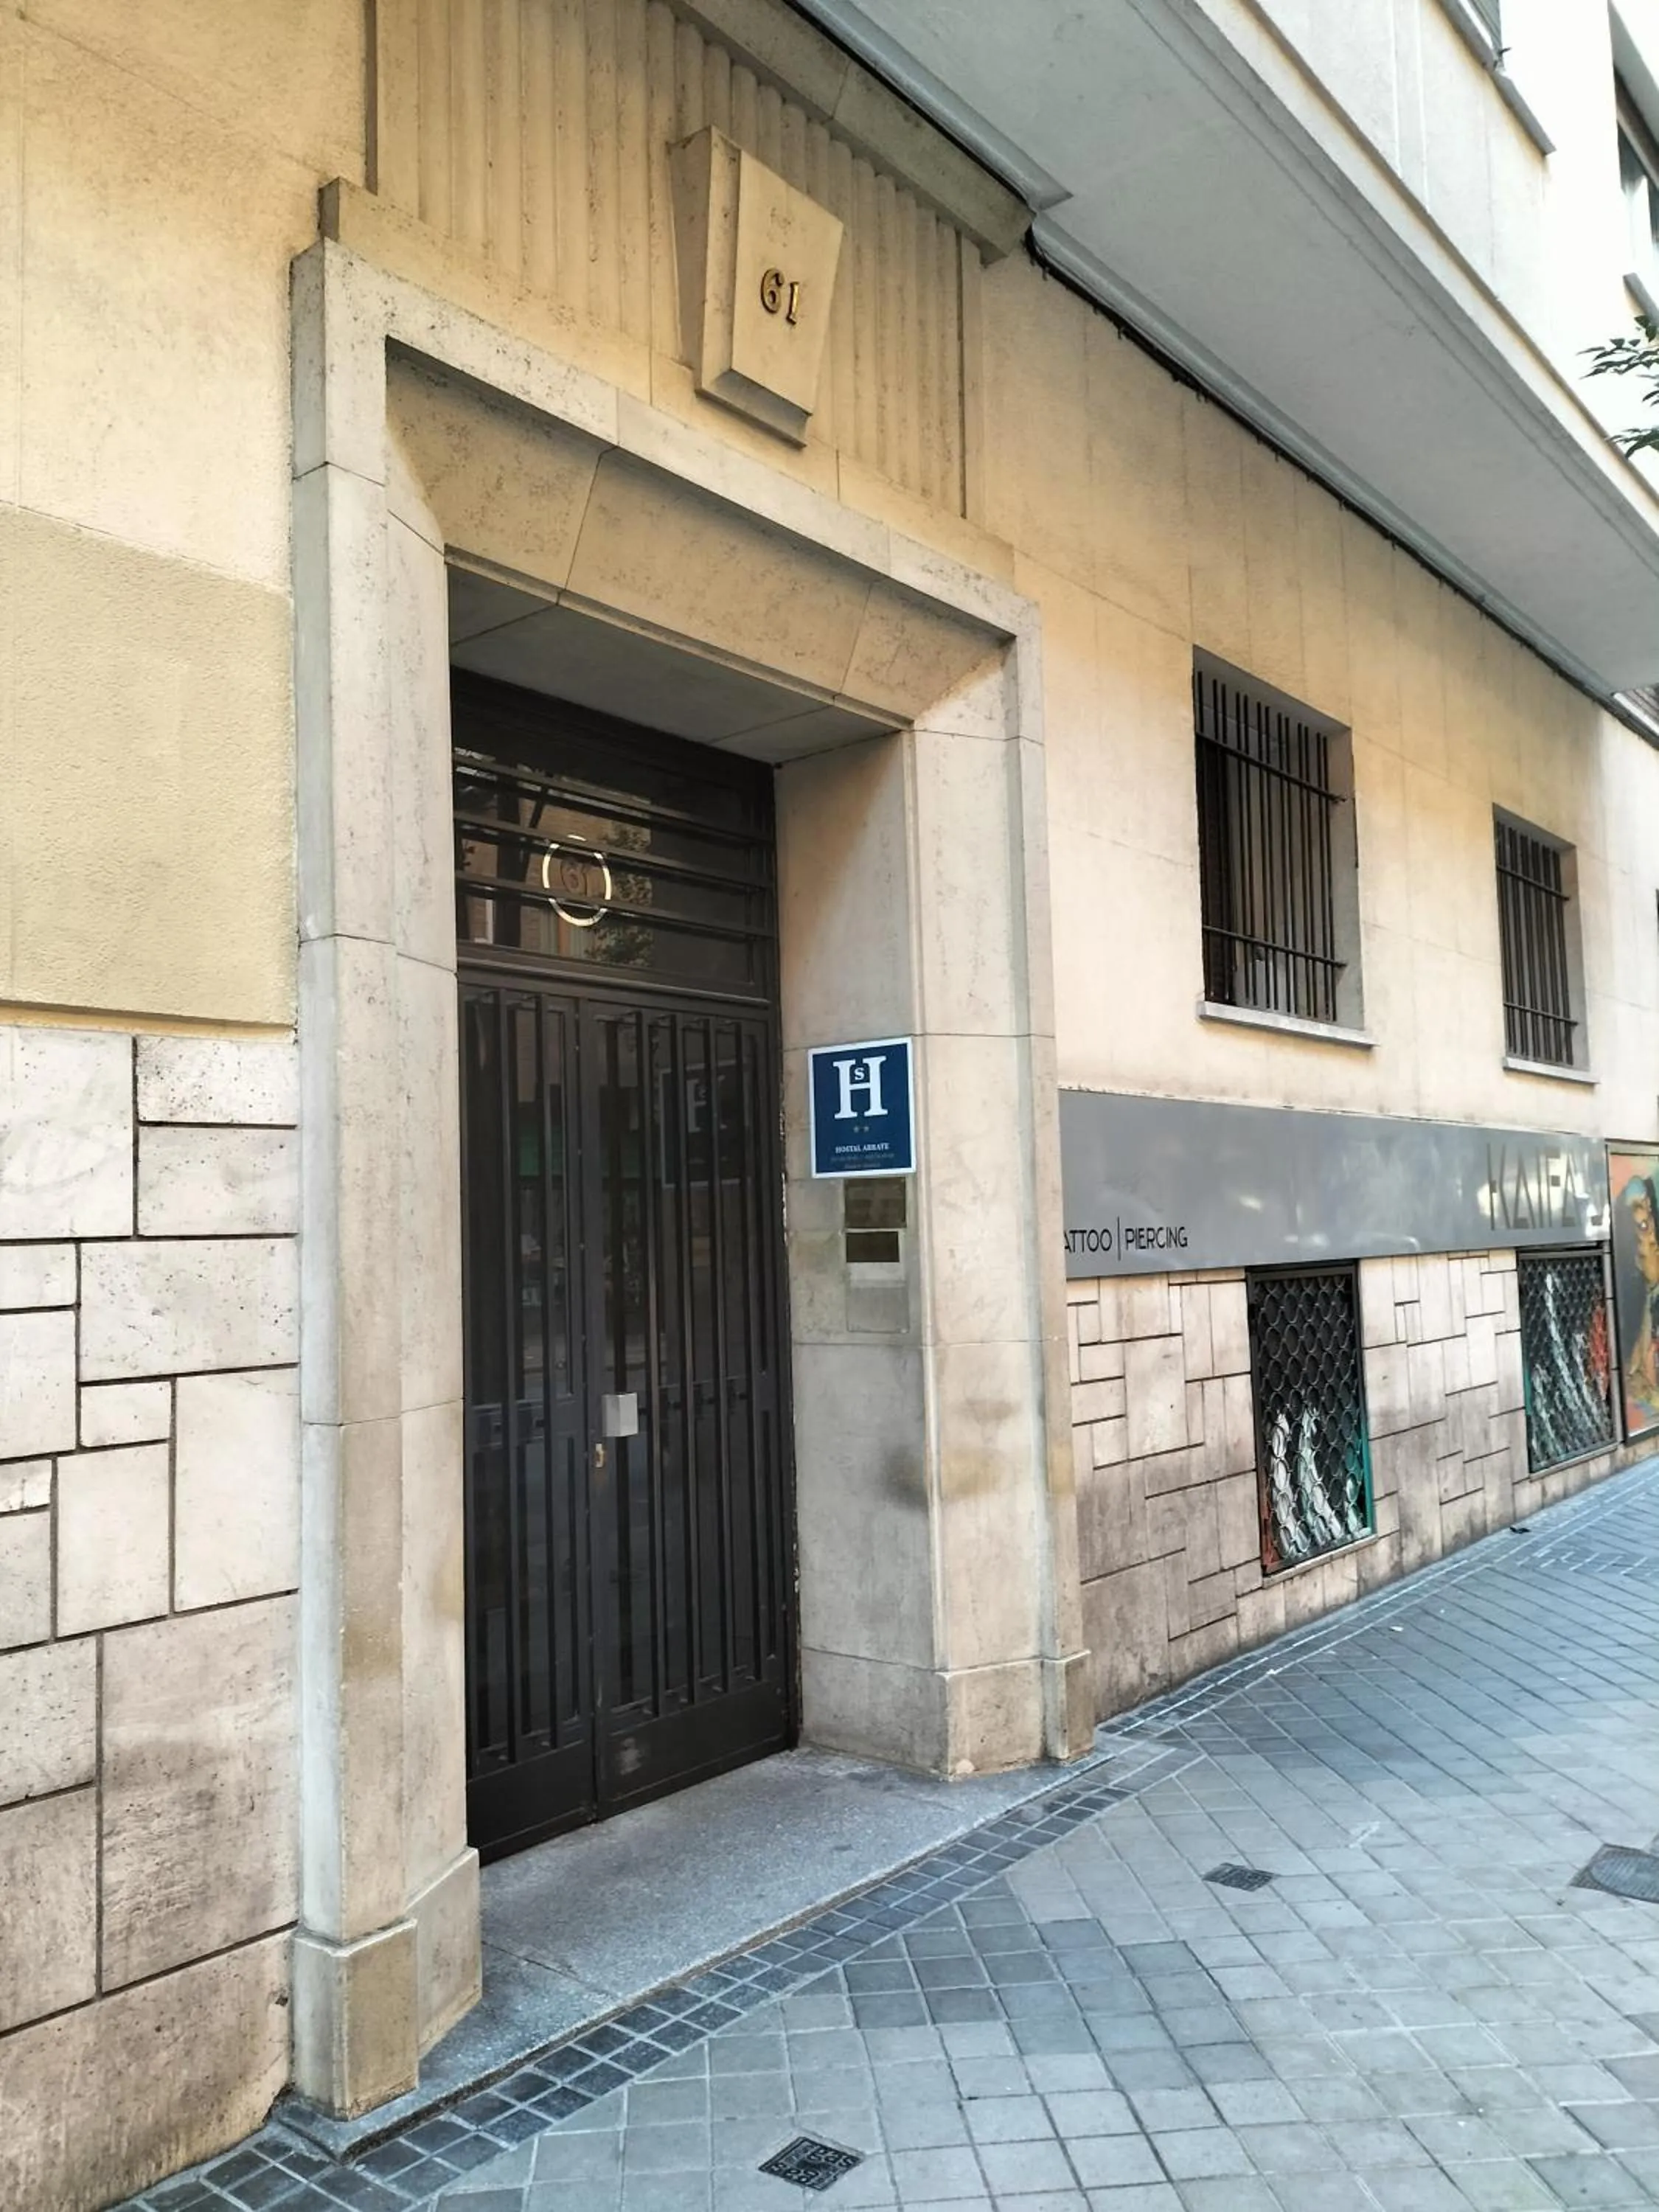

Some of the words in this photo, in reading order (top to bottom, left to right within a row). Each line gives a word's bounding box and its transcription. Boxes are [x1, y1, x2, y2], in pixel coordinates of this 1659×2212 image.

[760, 268, 799, 325] 61
[832, 1055, 888, 1119] H
[835, 1144, 861, 1154] HOSTAL
[1125, 1226, 1189, 1251] PIERCING
